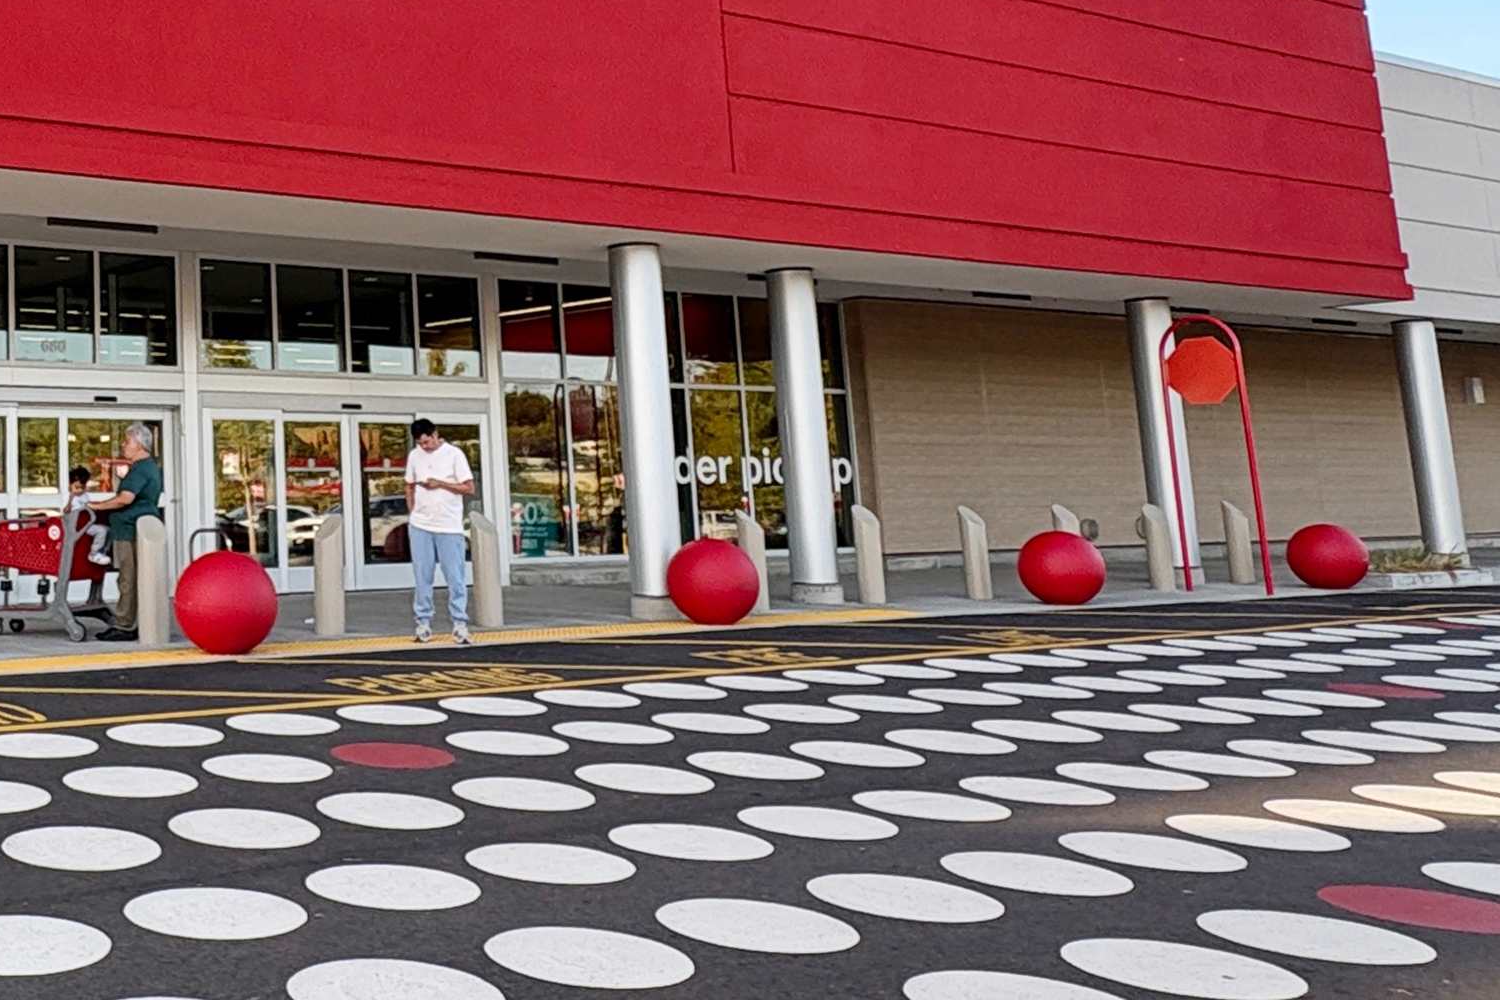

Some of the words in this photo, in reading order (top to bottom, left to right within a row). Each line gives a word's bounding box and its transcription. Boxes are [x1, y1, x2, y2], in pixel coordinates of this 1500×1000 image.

[675, 446, 732, 485] der
[741, 447, 852, 493] picp
[324, 668, 564, 696] PARKING
